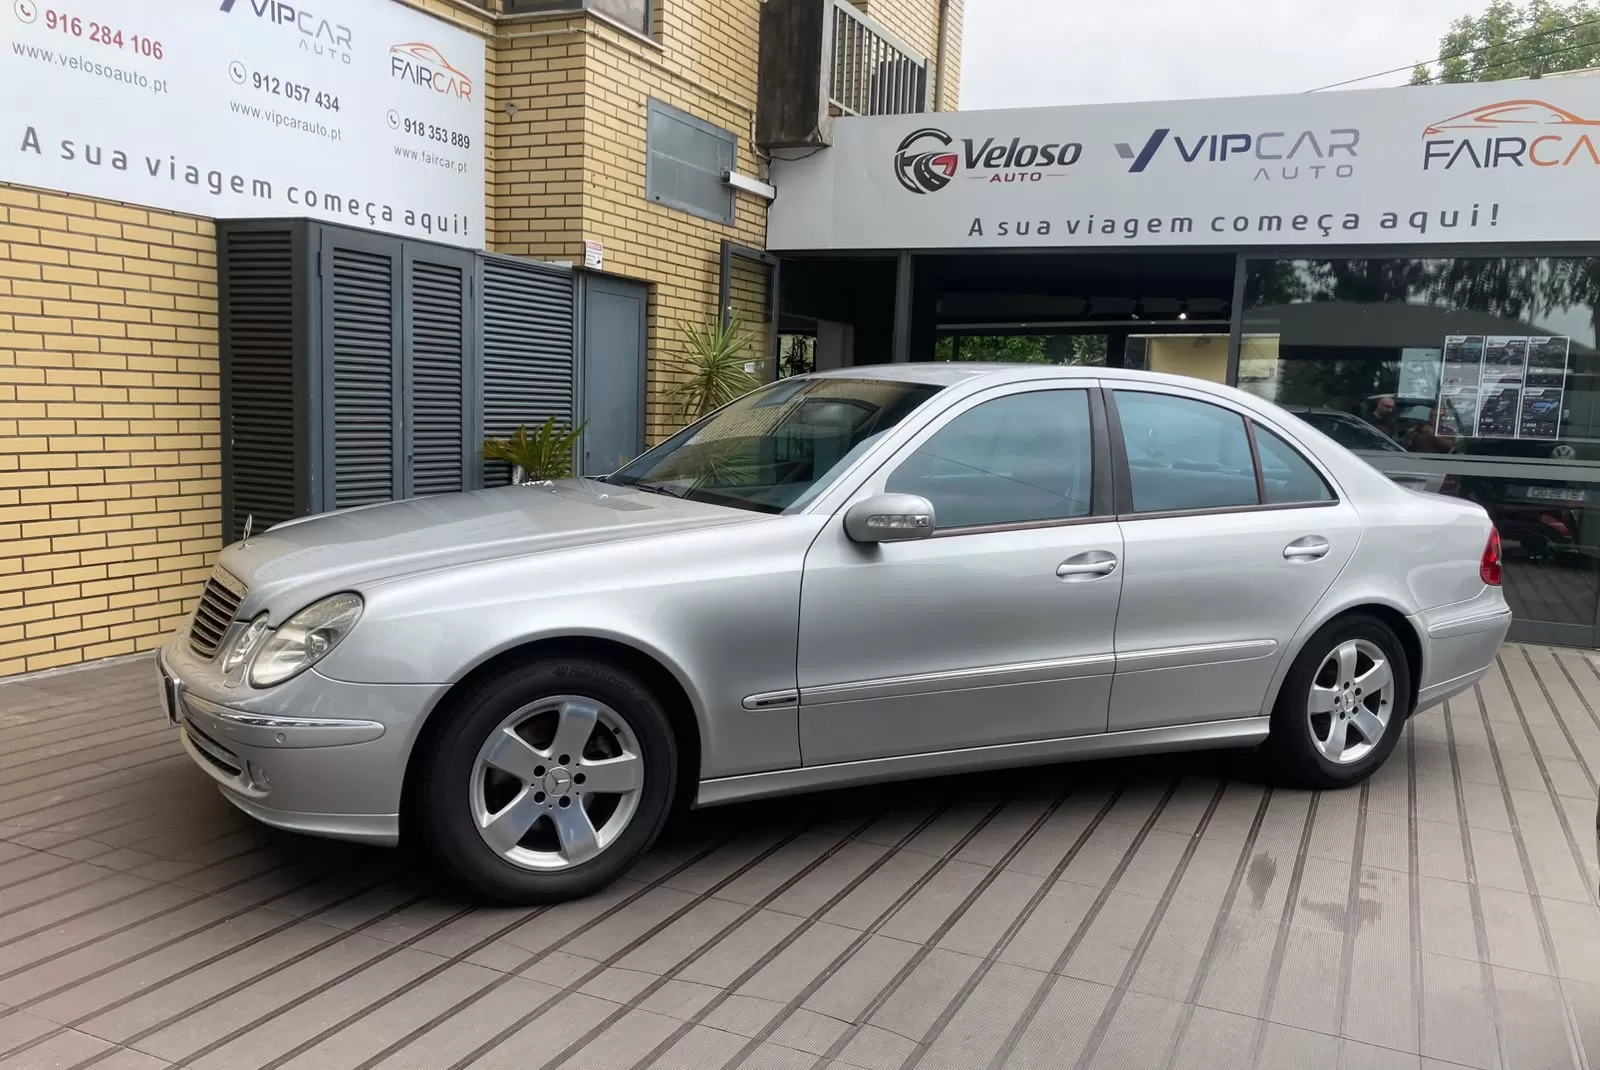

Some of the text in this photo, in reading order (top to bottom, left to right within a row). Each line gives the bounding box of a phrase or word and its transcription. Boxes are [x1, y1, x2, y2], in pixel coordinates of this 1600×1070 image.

[45, 9, 164, 60] 916 284 106
[251, 0, 353, 50] VIPCAR
[12, 41, 168, 94] www.velosoauto.pt
[299, 38, 352, 65] AUTO
[252, 71, 340, 112] 912 057 434
[391, 56, 472, 102] FAIRCAR
[229, 100, 342, 142] www.vipcarauto.pt
[404, 117, 471, 150] 918 353 889
[393, 145, 468, 174] www.faircar.pt
[960, 137, 1083, 169] Veloso
[1173, 128, 1360, 163] VIPCAR
[20, 126, 469, 236] A sua viagem começa aqui!
[989, 172, 1042, 183] AUTO
[1253, 164, 1353, 181] AUTO
[968, 203, 1499, 239] A sua viagem começa aqui!
